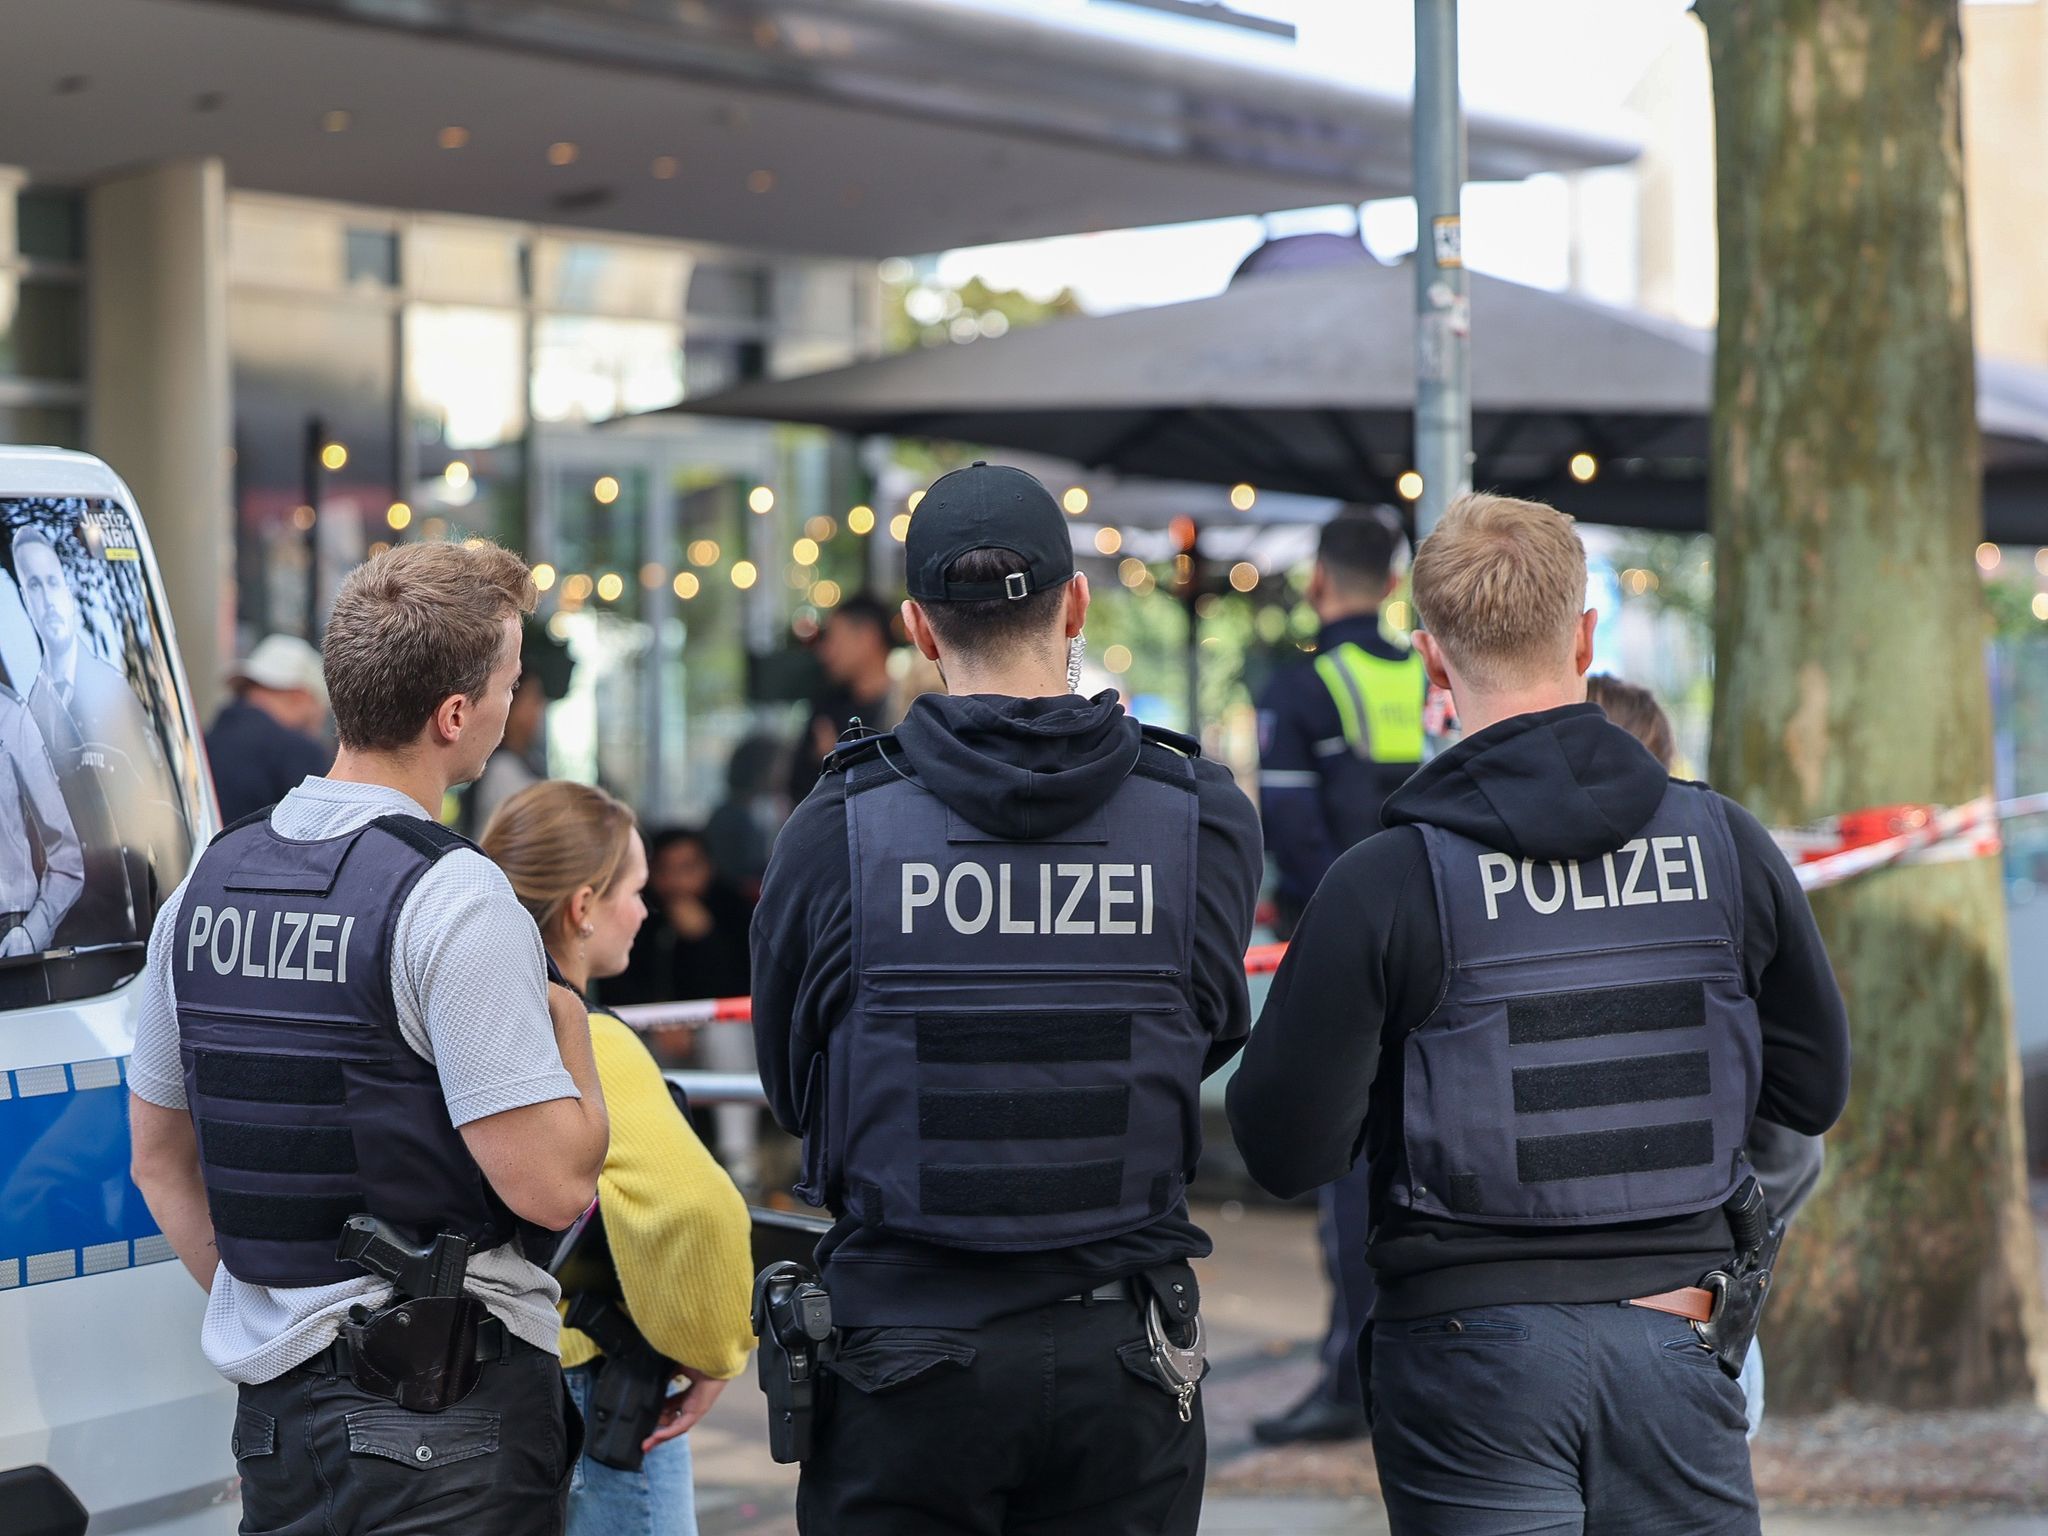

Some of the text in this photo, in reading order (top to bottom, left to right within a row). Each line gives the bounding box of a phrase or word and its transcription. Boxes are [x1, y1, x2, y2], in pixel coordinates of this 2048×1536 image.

[100, 528, 136, 548] NRW
[901, 861, 1154, 935] POLIZEI
[1477, 835, 1709, 920] POLIZEI
[187, 905, 356, 983] POLIZEI
